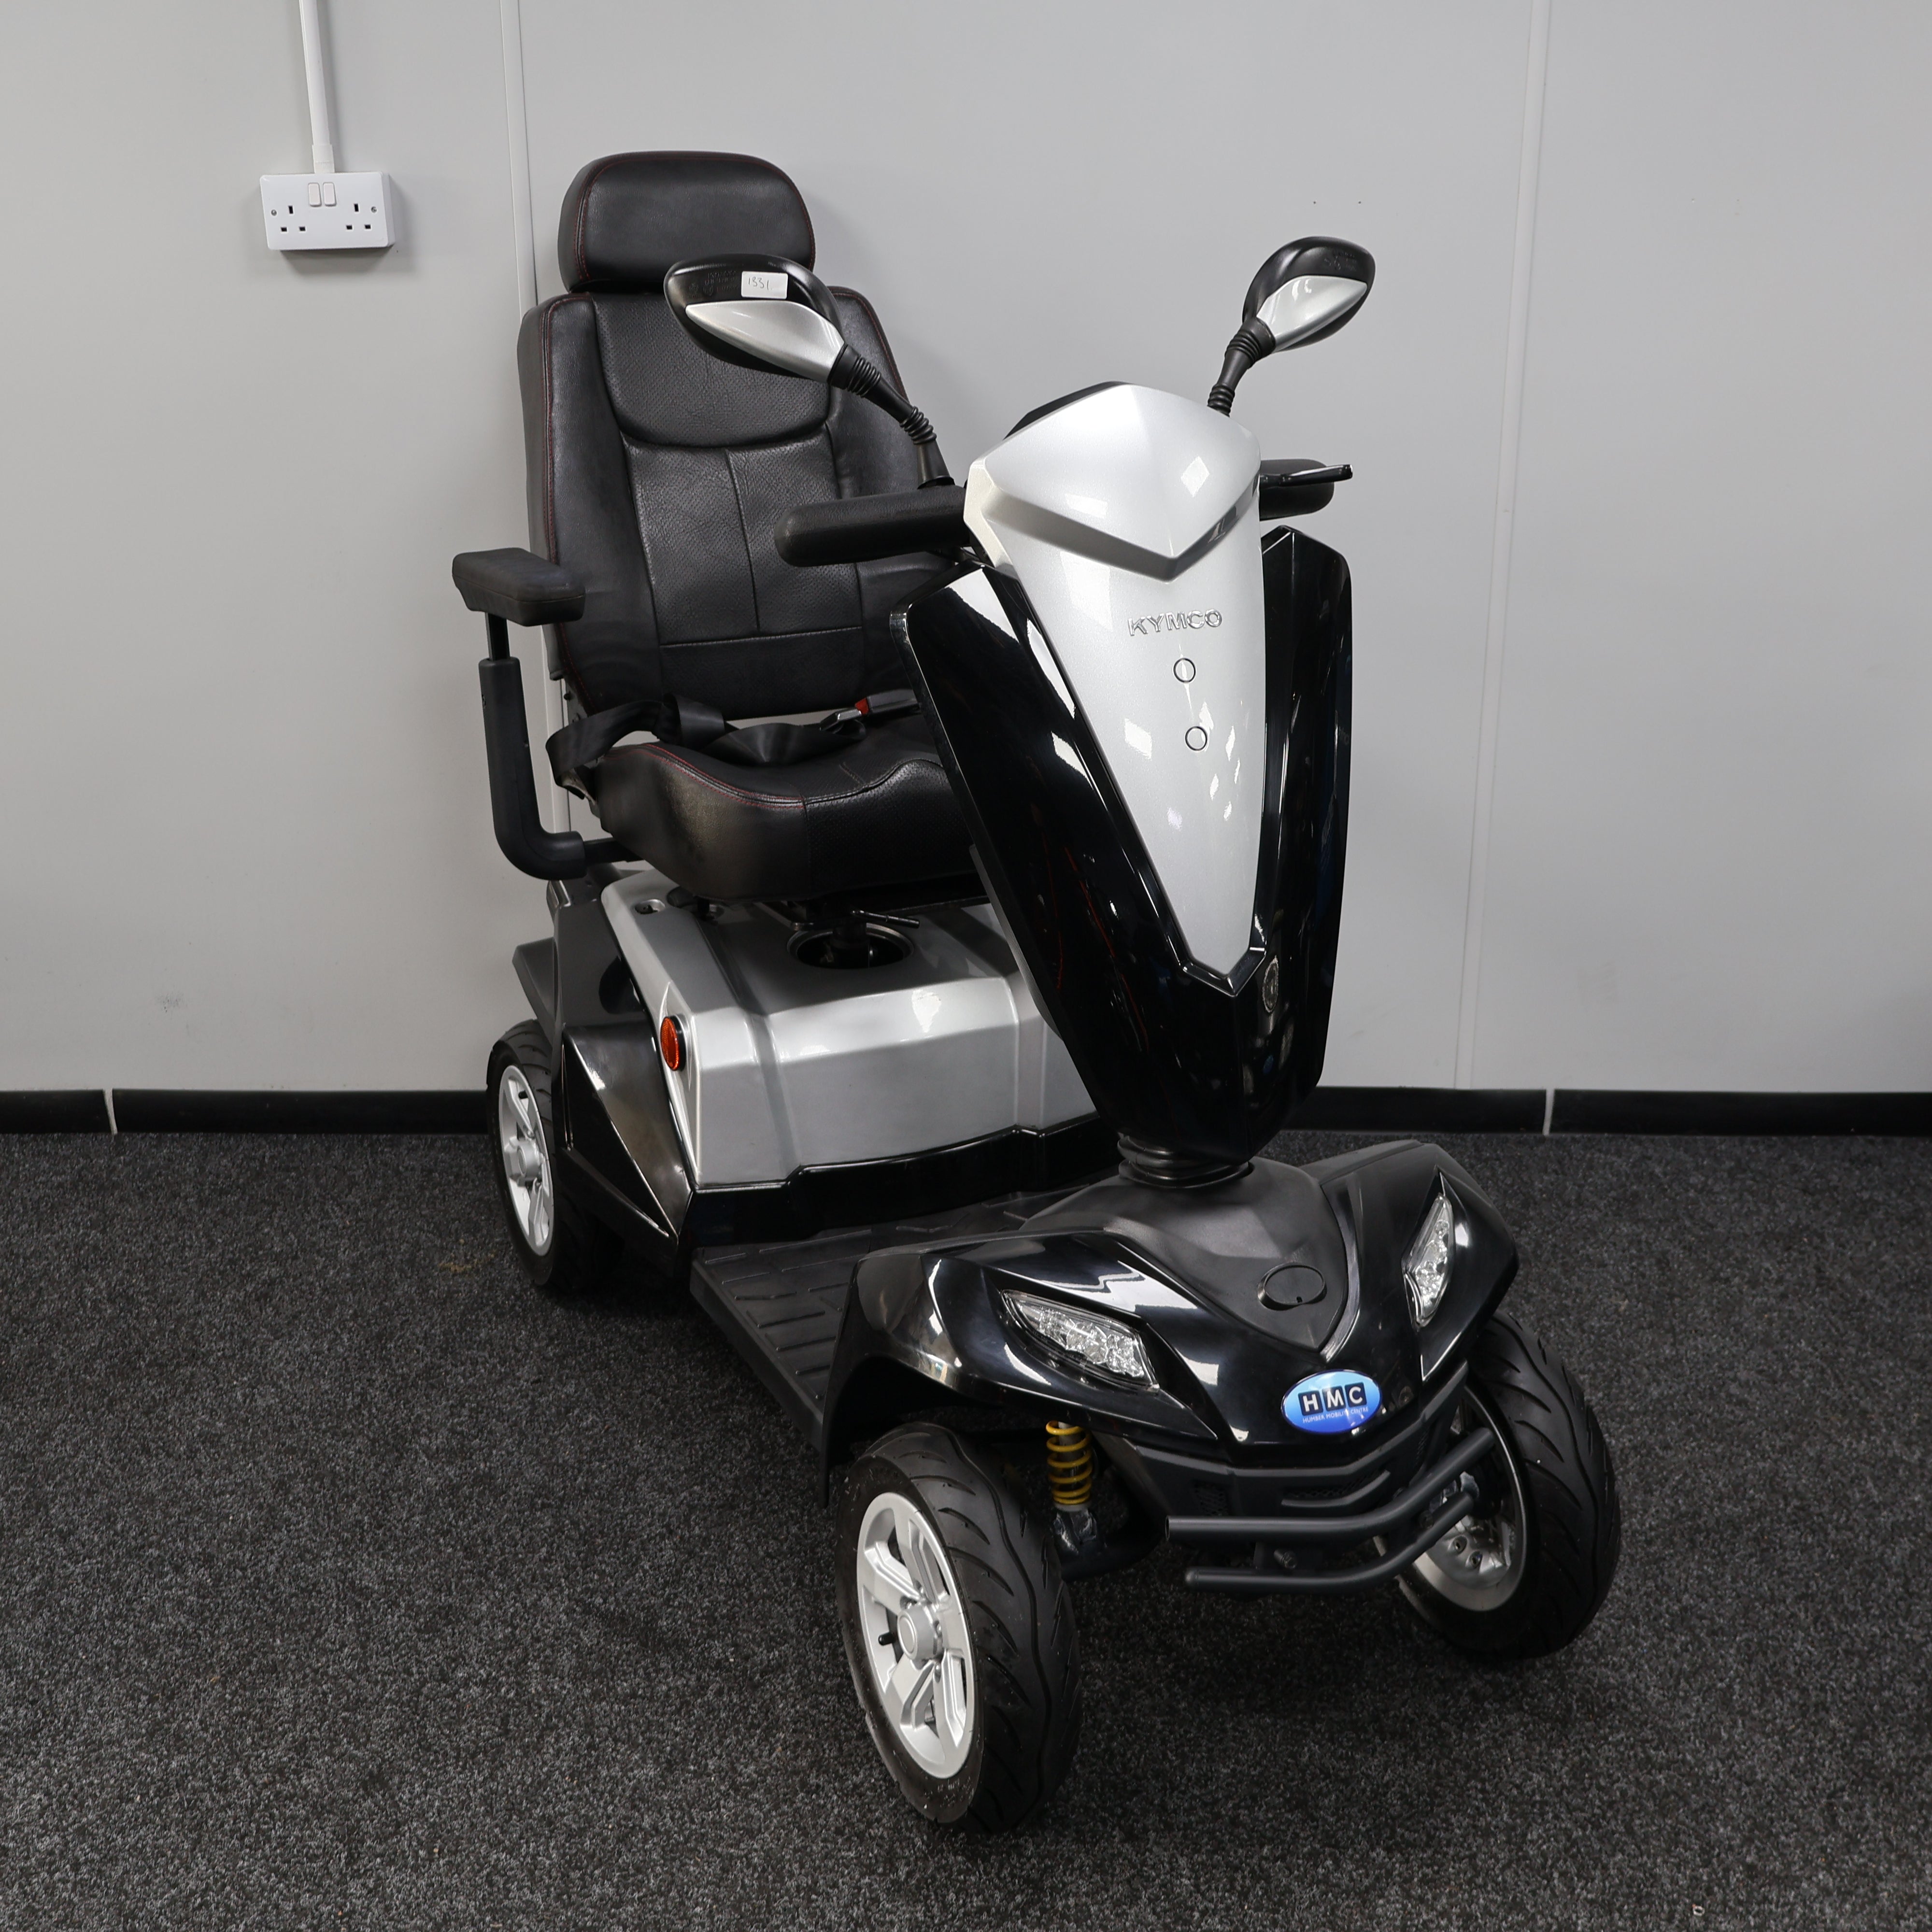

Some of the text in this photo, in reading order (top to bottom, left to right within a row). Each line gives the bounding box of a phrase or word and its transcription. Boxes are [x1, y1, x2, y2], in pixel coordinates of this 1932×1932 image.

[1128, 609, 1222, 637] KYMCO
[1303, 1386, 1363, 1413] HMC
[1303, 1415, 1325, 1423] HUMBER
[1350, 1406, 1369, 1415] CENTRE
